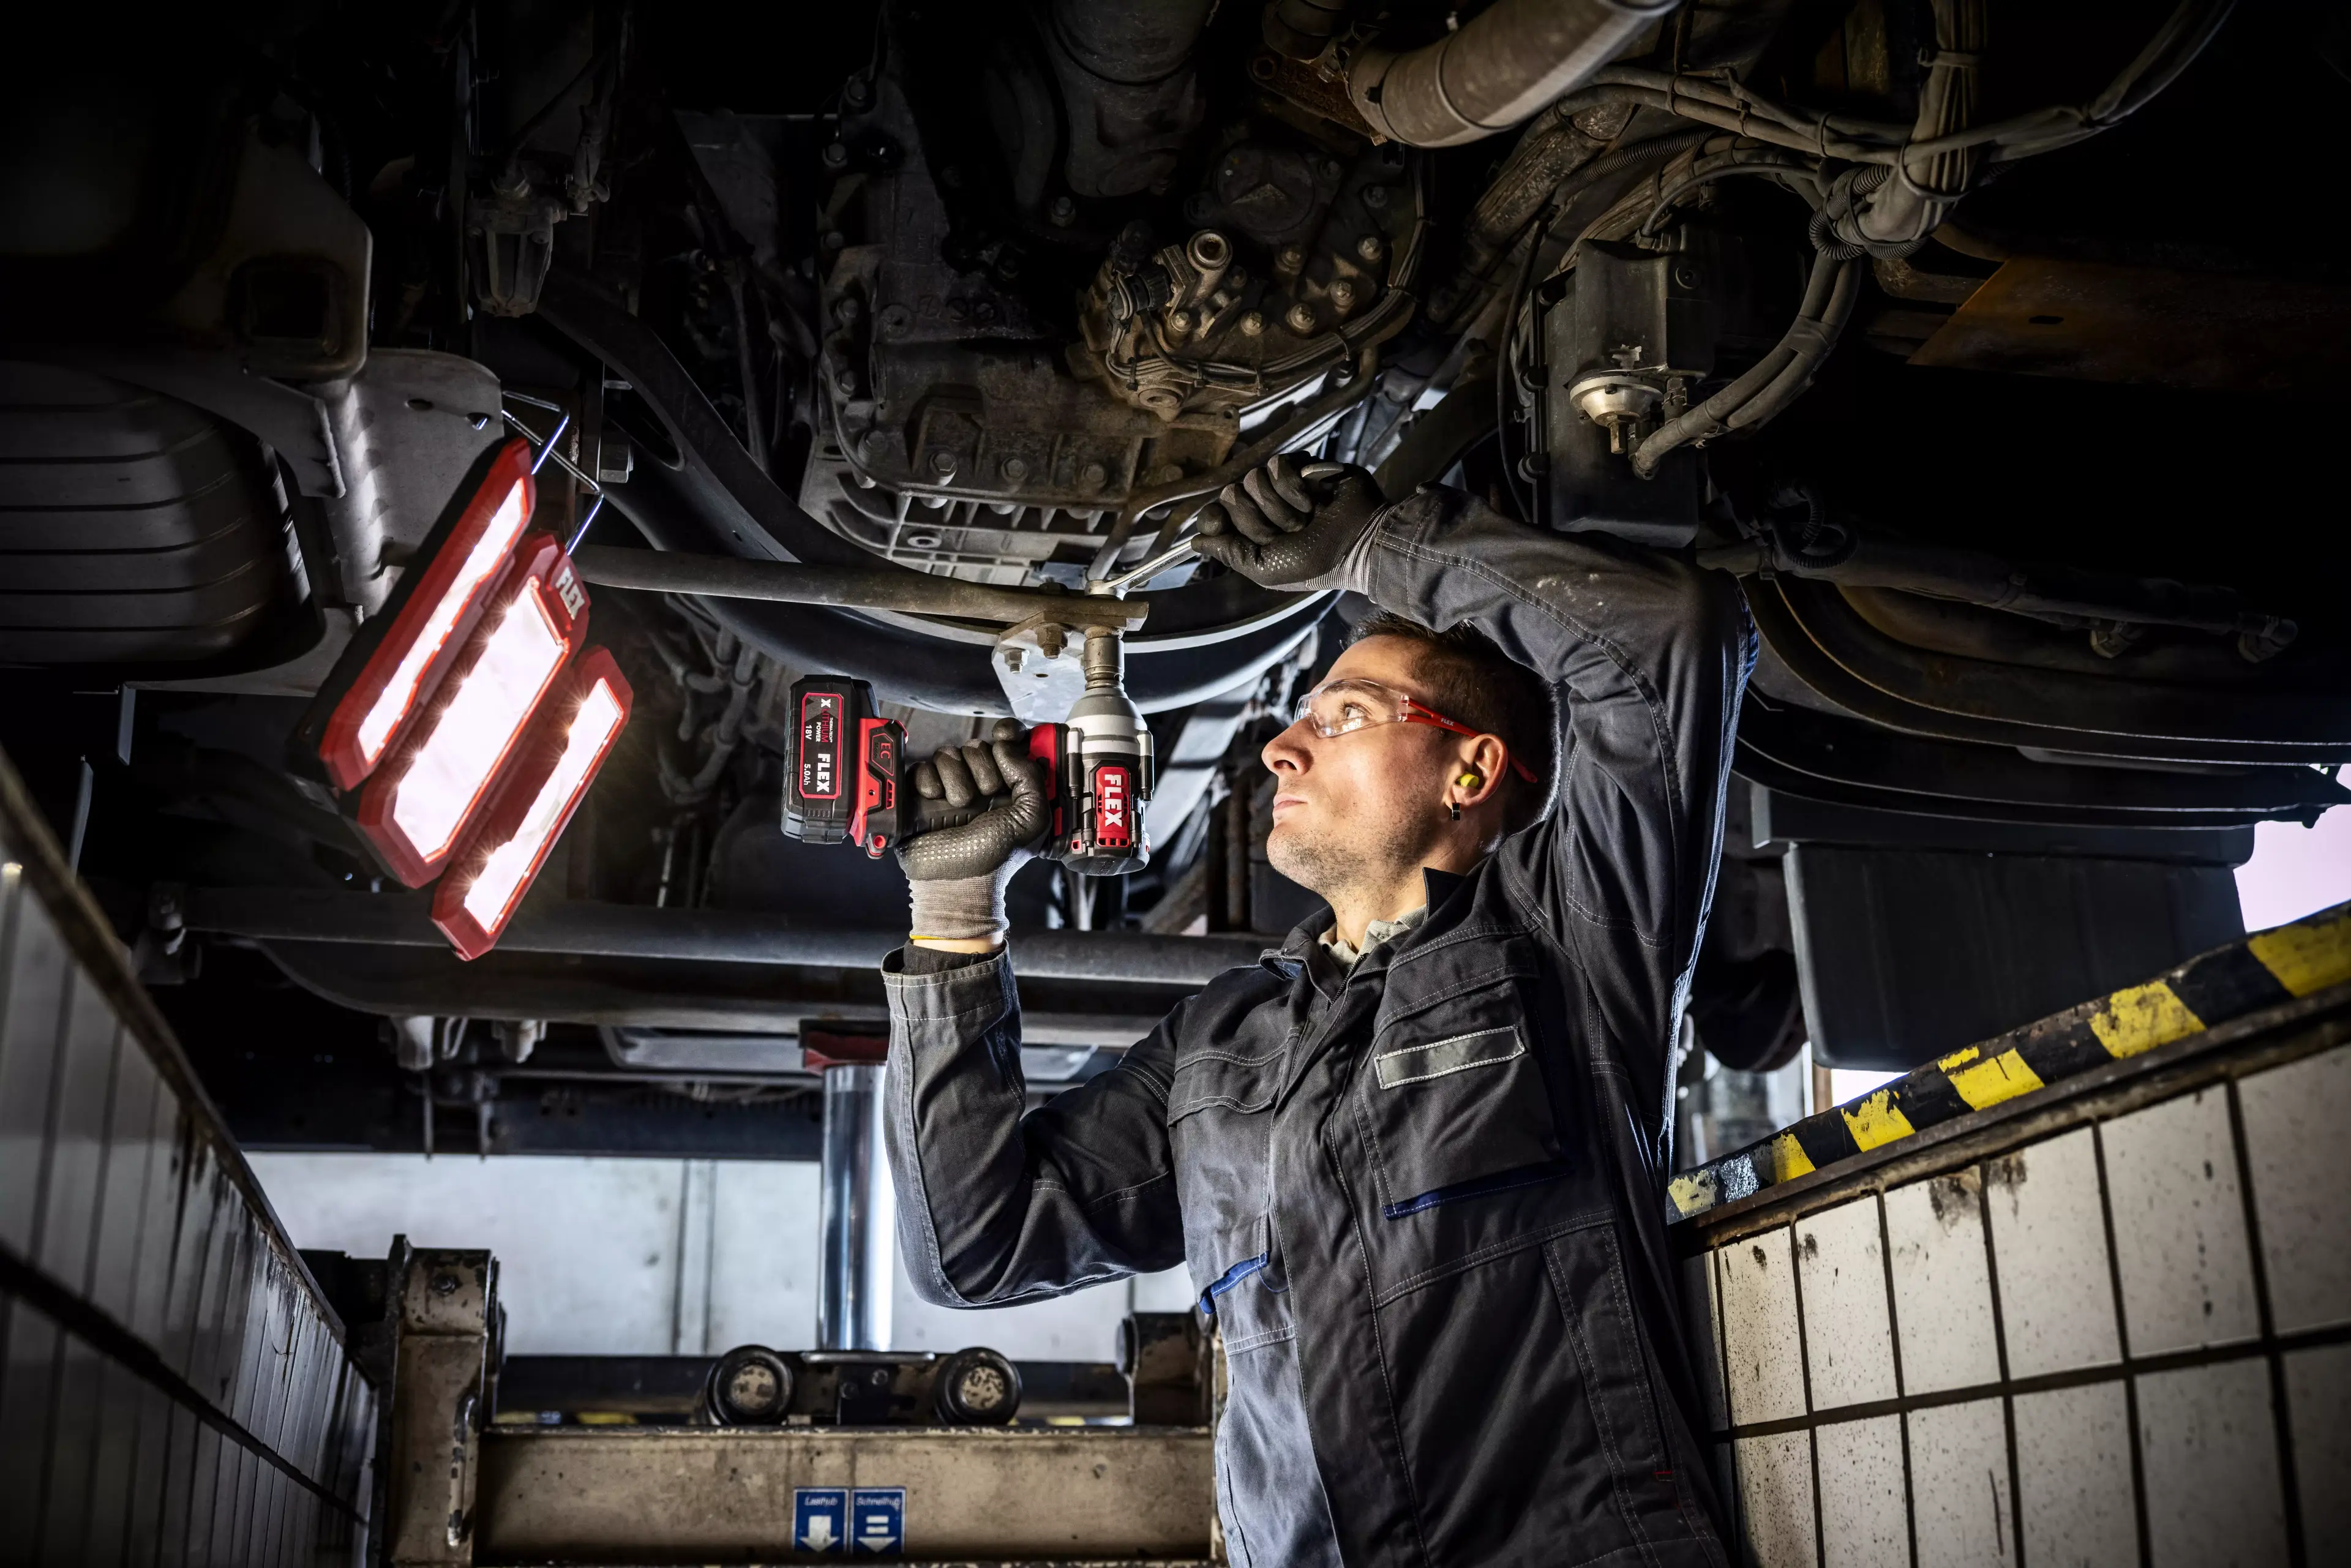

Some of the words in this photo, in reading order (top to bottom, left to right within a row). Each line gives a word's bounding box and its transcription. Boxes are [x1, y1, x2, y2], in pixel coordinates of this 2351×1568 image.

[555, 566, 585, 620] FLEX
[820, 698, 831, 708] X
[821, 708, 830, 743] LITHIUM
[1441, 718, 1454, 727] FLEX
[880, 743, 891, 759] EC
[816, 753, 831, 793] FLEX
[1104, 774, 1122, 827] FLEX
